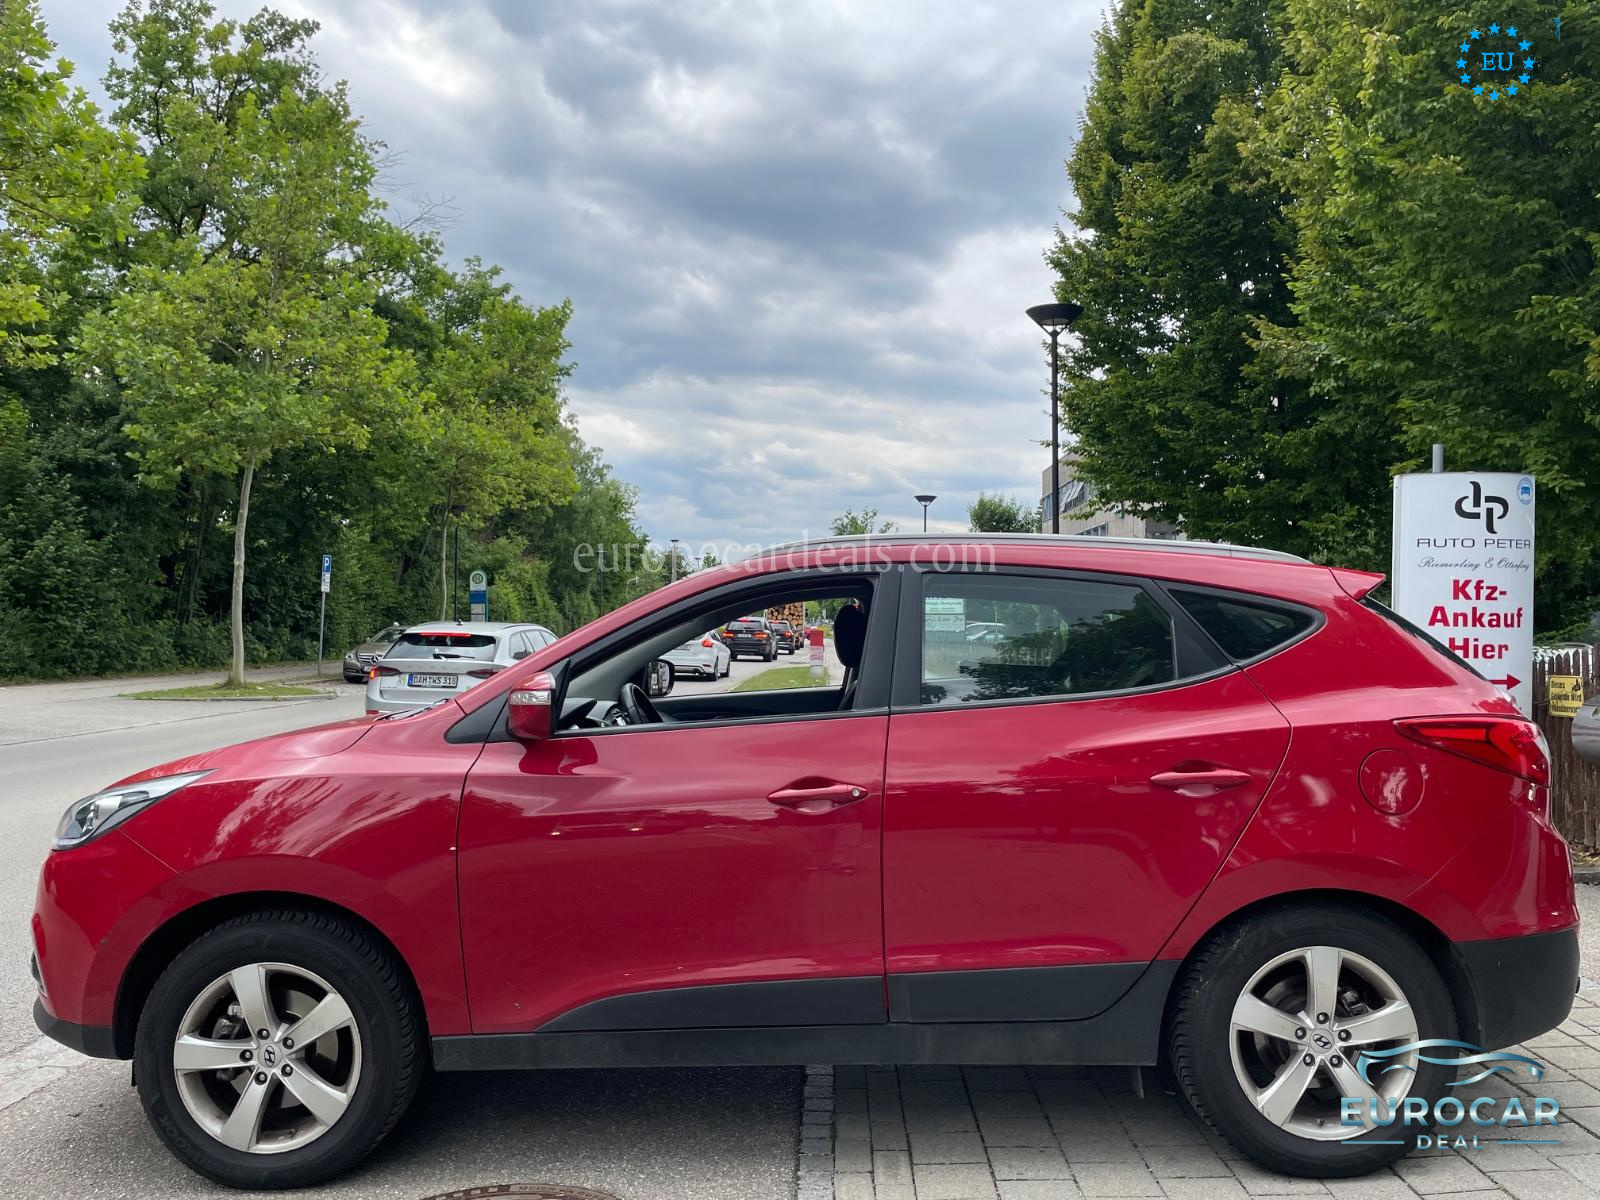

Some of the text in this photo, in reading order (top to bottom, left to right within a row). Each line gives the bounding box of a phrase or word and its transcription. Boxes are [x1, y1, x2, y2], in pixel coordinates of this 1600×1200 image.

[1417, 538, 1531, 549] AUTO PETER
[1452, 579, 1507, 600] Kfz-
[1428, 606, 1522, 628] Ankauf
[1449, 637, 1509, 659] Hier
